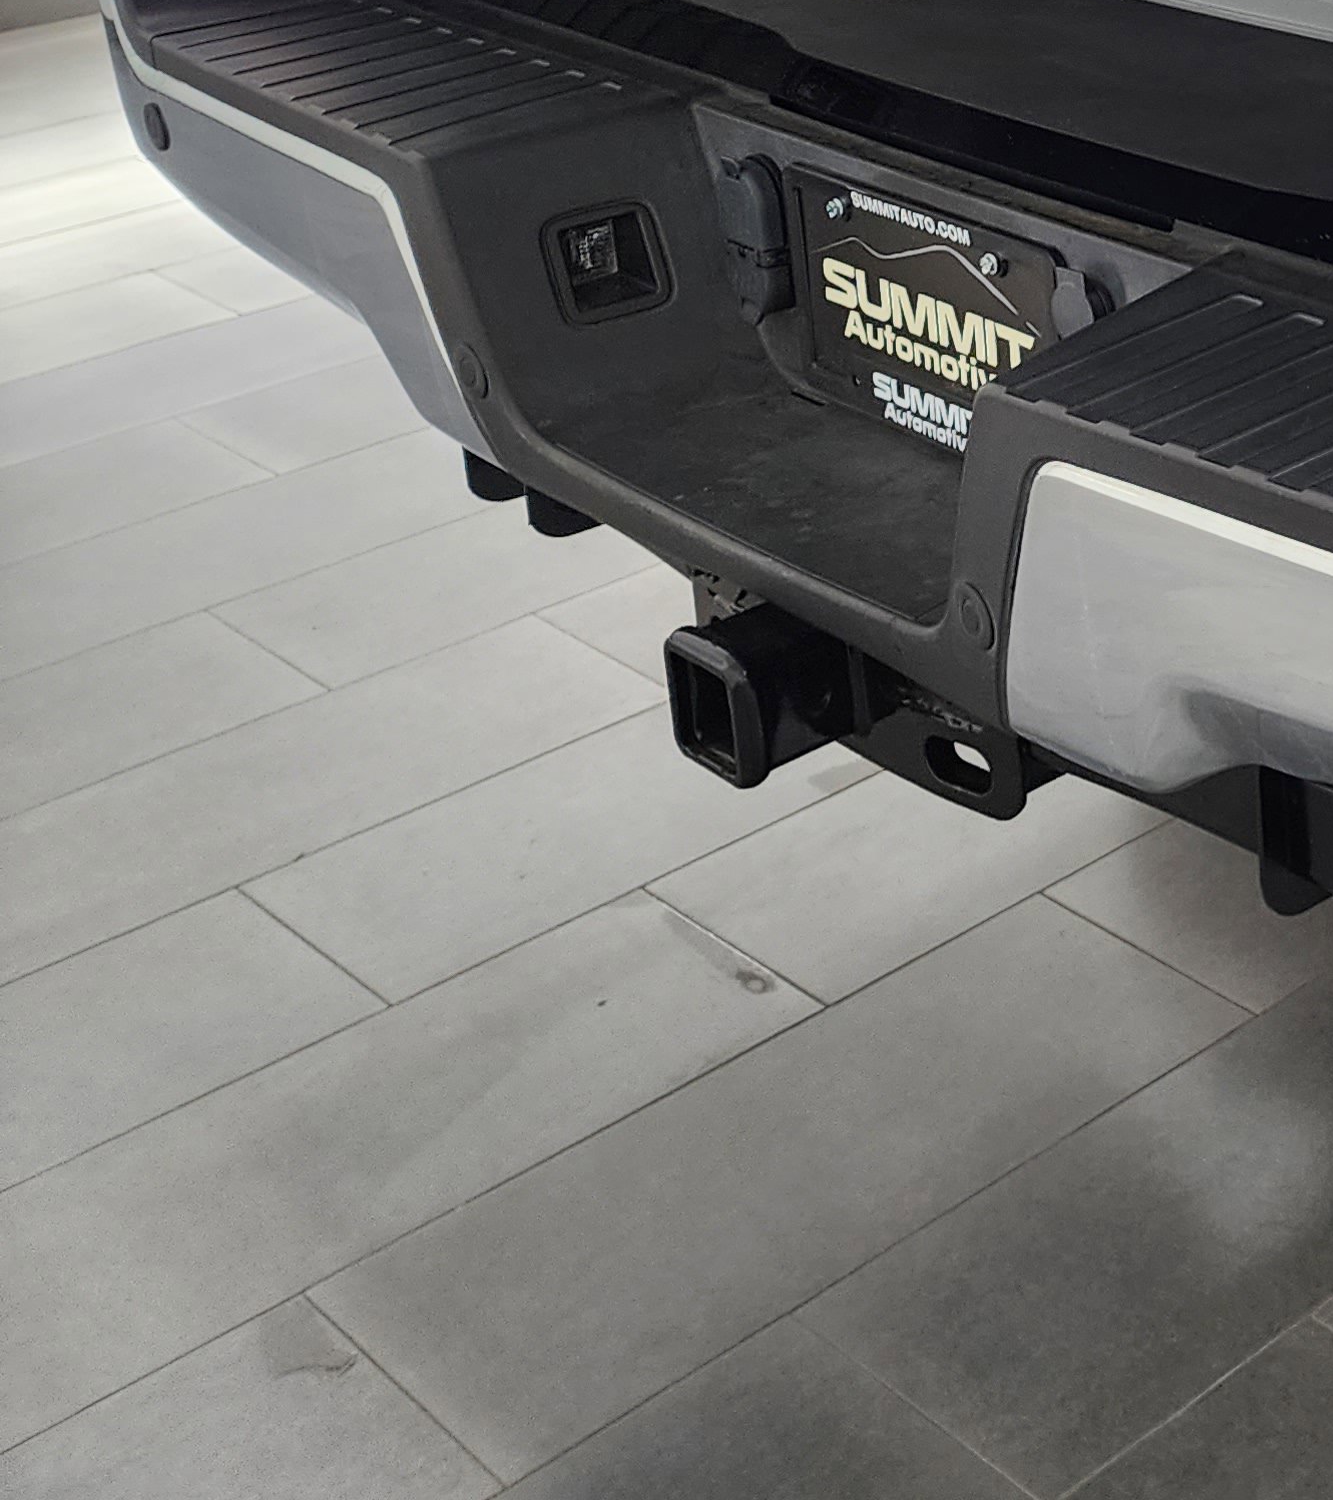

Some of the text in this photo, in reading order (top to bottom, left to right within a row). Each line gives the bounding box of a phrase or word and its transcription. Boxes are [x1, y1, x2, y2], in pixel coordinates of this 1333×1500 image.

[851, 191, 972, 247] SUMMITAUTO.COM
[822, 256, 1035, 370] SUMMIT
[844, 310, 999, 391] Automotiv
